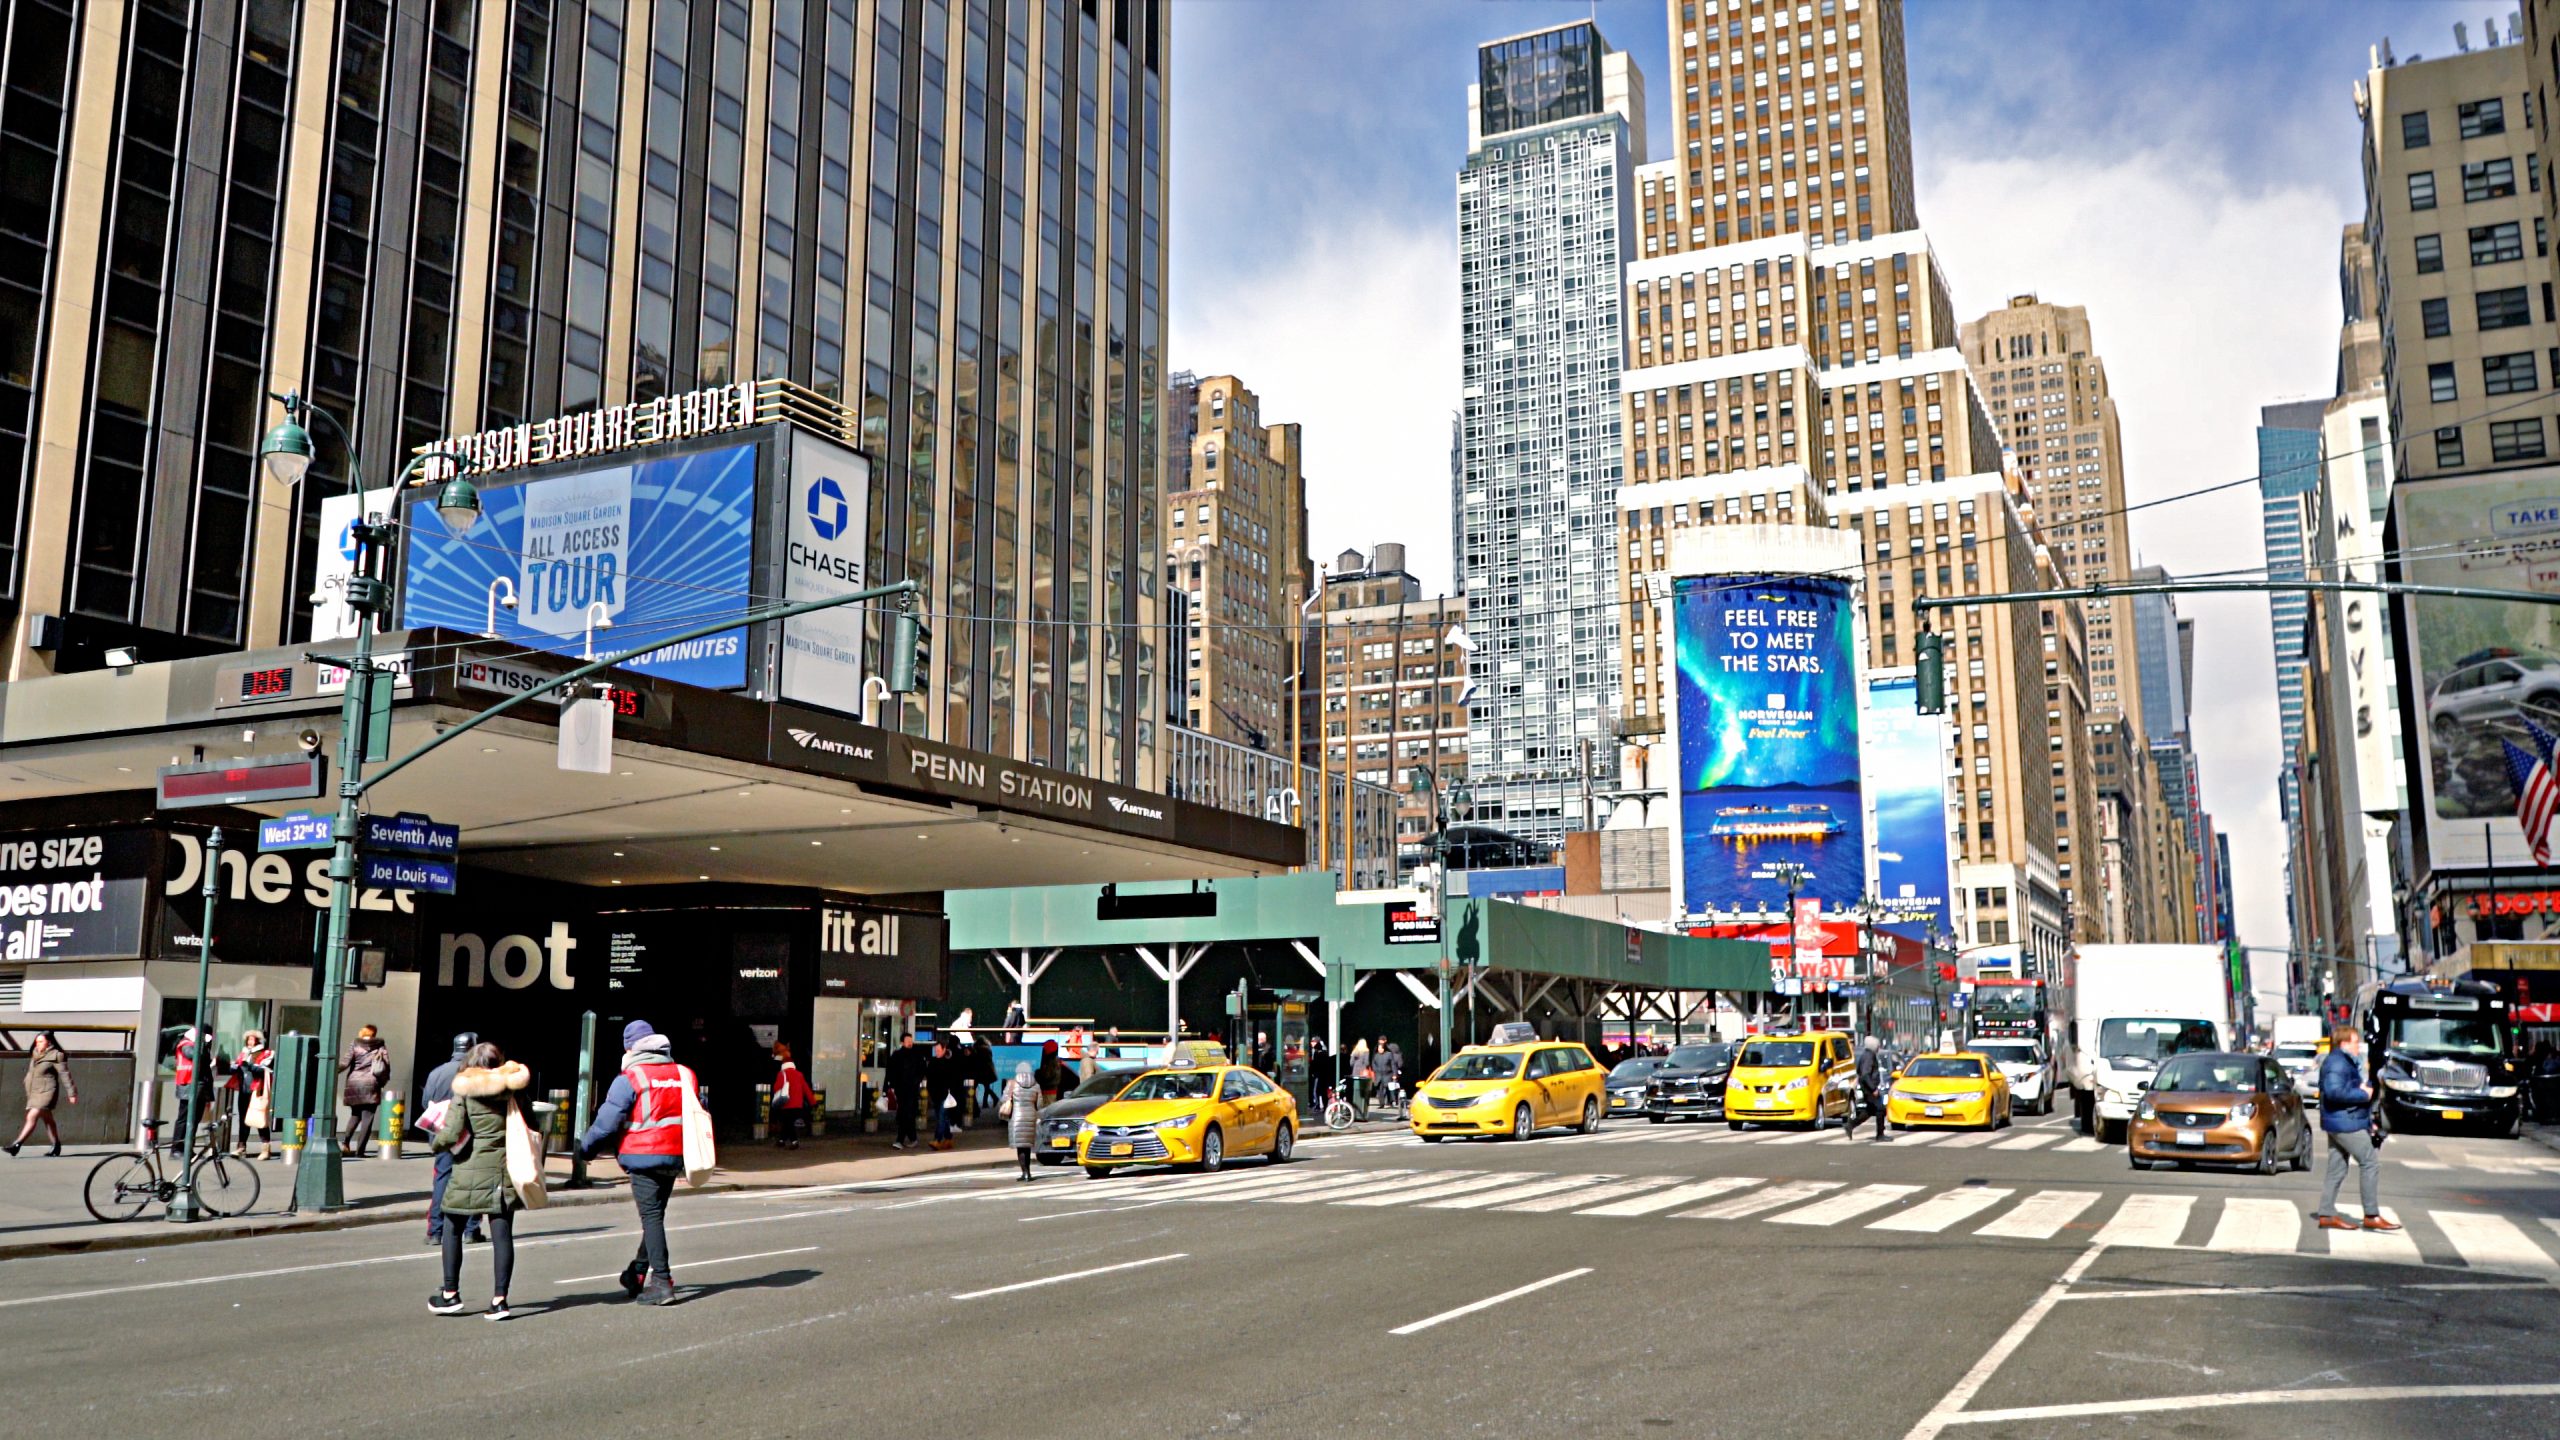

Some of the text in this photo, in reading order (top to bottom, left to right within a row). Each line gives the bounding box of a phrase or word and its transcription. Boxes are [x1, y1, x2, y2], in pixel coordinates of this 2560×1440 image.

[425, 380, 757, 482] MADISON SQUARE GARDEN
[530, 504, 622, 530] MADISON SQUARE GARDEN
[2508, 508, 2559, 525] TAKE
[529, 524, 620, 560] ALL ACCESS
[789, 542, 860, 585] CHASE
[527, 552, 617, 615] TOUR
[1725, 609, 1818, 628] FEEL FREE
[655, 636, 739, 663] MINUTES
[786, 633, 856, 665] MADISON SQUARE GARDEN
[1729, 631, 1815, 650] TO MEET
[1720, 654, 1824, 674] THE STARS.
[250, 668, 285, 695] 1:15
[1738, 709, 1814, 721] NORWEGIAN
[1749, 727, 1806, 739] Feel Free
[811, 738, 874, 760] AMTRAK
[911, 748, 1092, 811] PENN STATION
[1122, 803, 1162, 821] AMTRAK
[265, 822, 327, 844] West 32nd St
[371, 823, 454, 848] Seventh Ave
[0, 835, 103, 871] ne size
[371, 864, 449, 884] Joe Louis Plaza
[50, 871, 105, 914] not
[6, 919, 43, 960] all
[174, 934, 213, 947] verizn
[821, 907, 899, 957] fit all
[437, 921, 577, 990] not
[739, 967, 778, 979] verizon
[651, 1078, 683, 1088] BuzzFee
